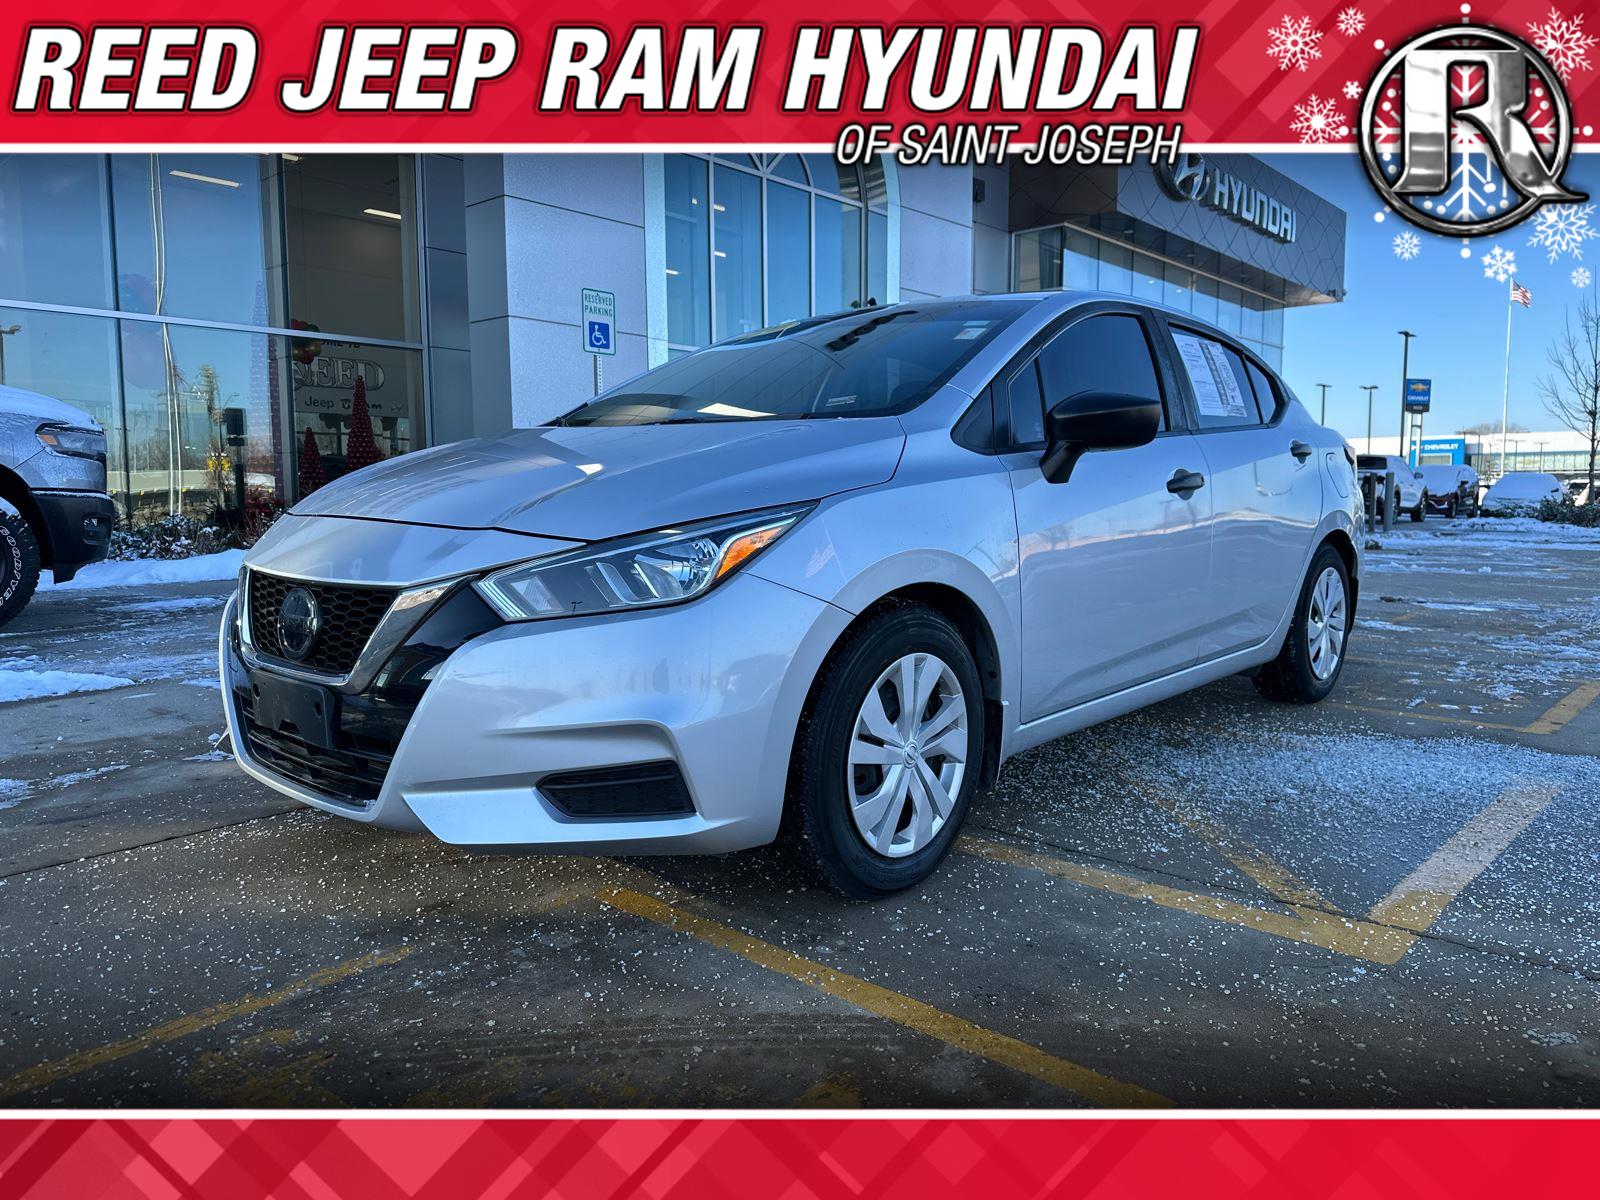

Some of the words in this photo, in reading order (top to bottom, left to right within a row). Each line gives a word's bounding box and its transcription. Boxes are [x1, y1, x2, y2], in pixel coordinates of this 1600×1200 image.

[1214, 167, 1297, 243] HYUNDAI
[584, 293, 613, 306] RESERVED
[584, 304, 613, 317] PARKING
[304, 396, 335, 410] Jeep
[1424, 443, 1459, 451] CHEVROLET
